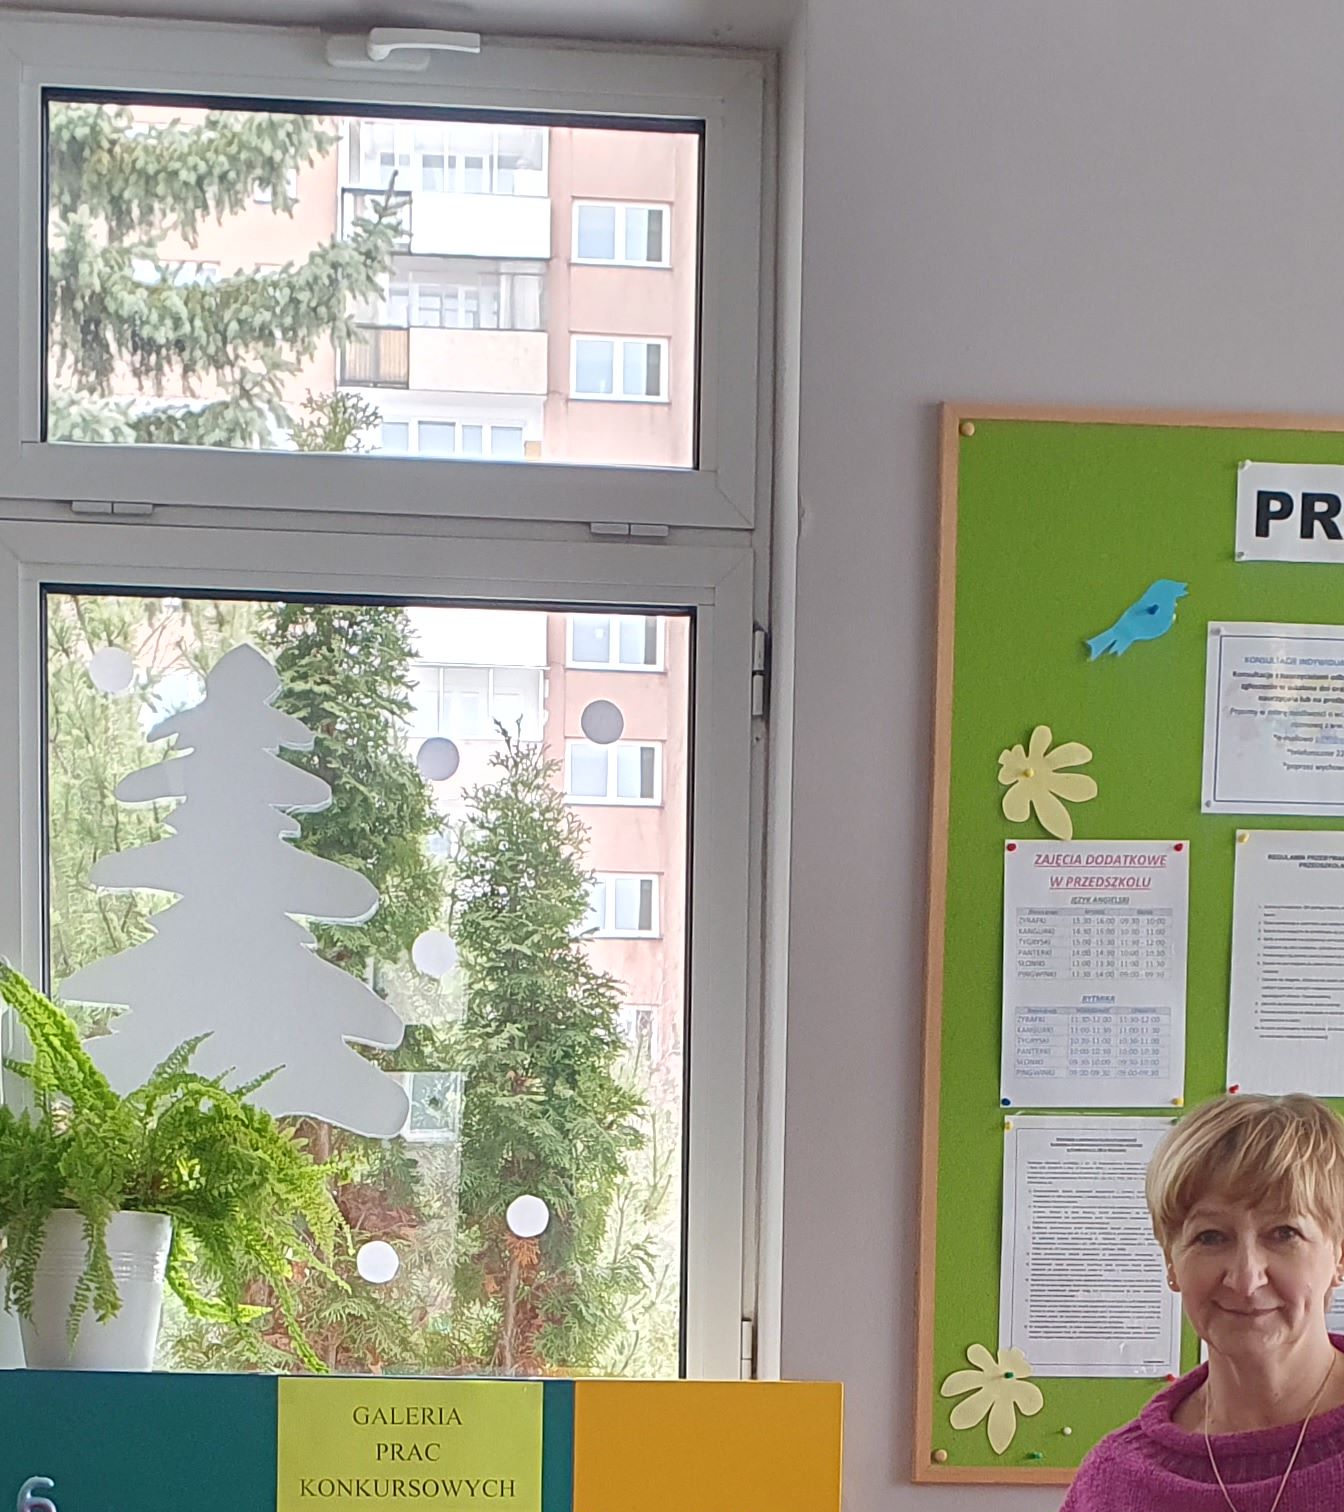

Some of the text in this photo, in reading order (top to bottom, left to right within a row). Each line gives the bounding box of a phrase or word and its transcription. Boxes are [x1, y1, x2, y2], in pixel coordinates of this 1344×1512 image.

[1034, 855, 1167, 867] ZAJĘCIA DODATKOWE
[1050, 877, 1151, 888] W PRZEDSZKOLU
[353, 1406, 463, 1426] GALERIA
[376, 1443, 441, 1462] PRAC
[300, 1478, 515, 1498] KONKURSOWYCH
